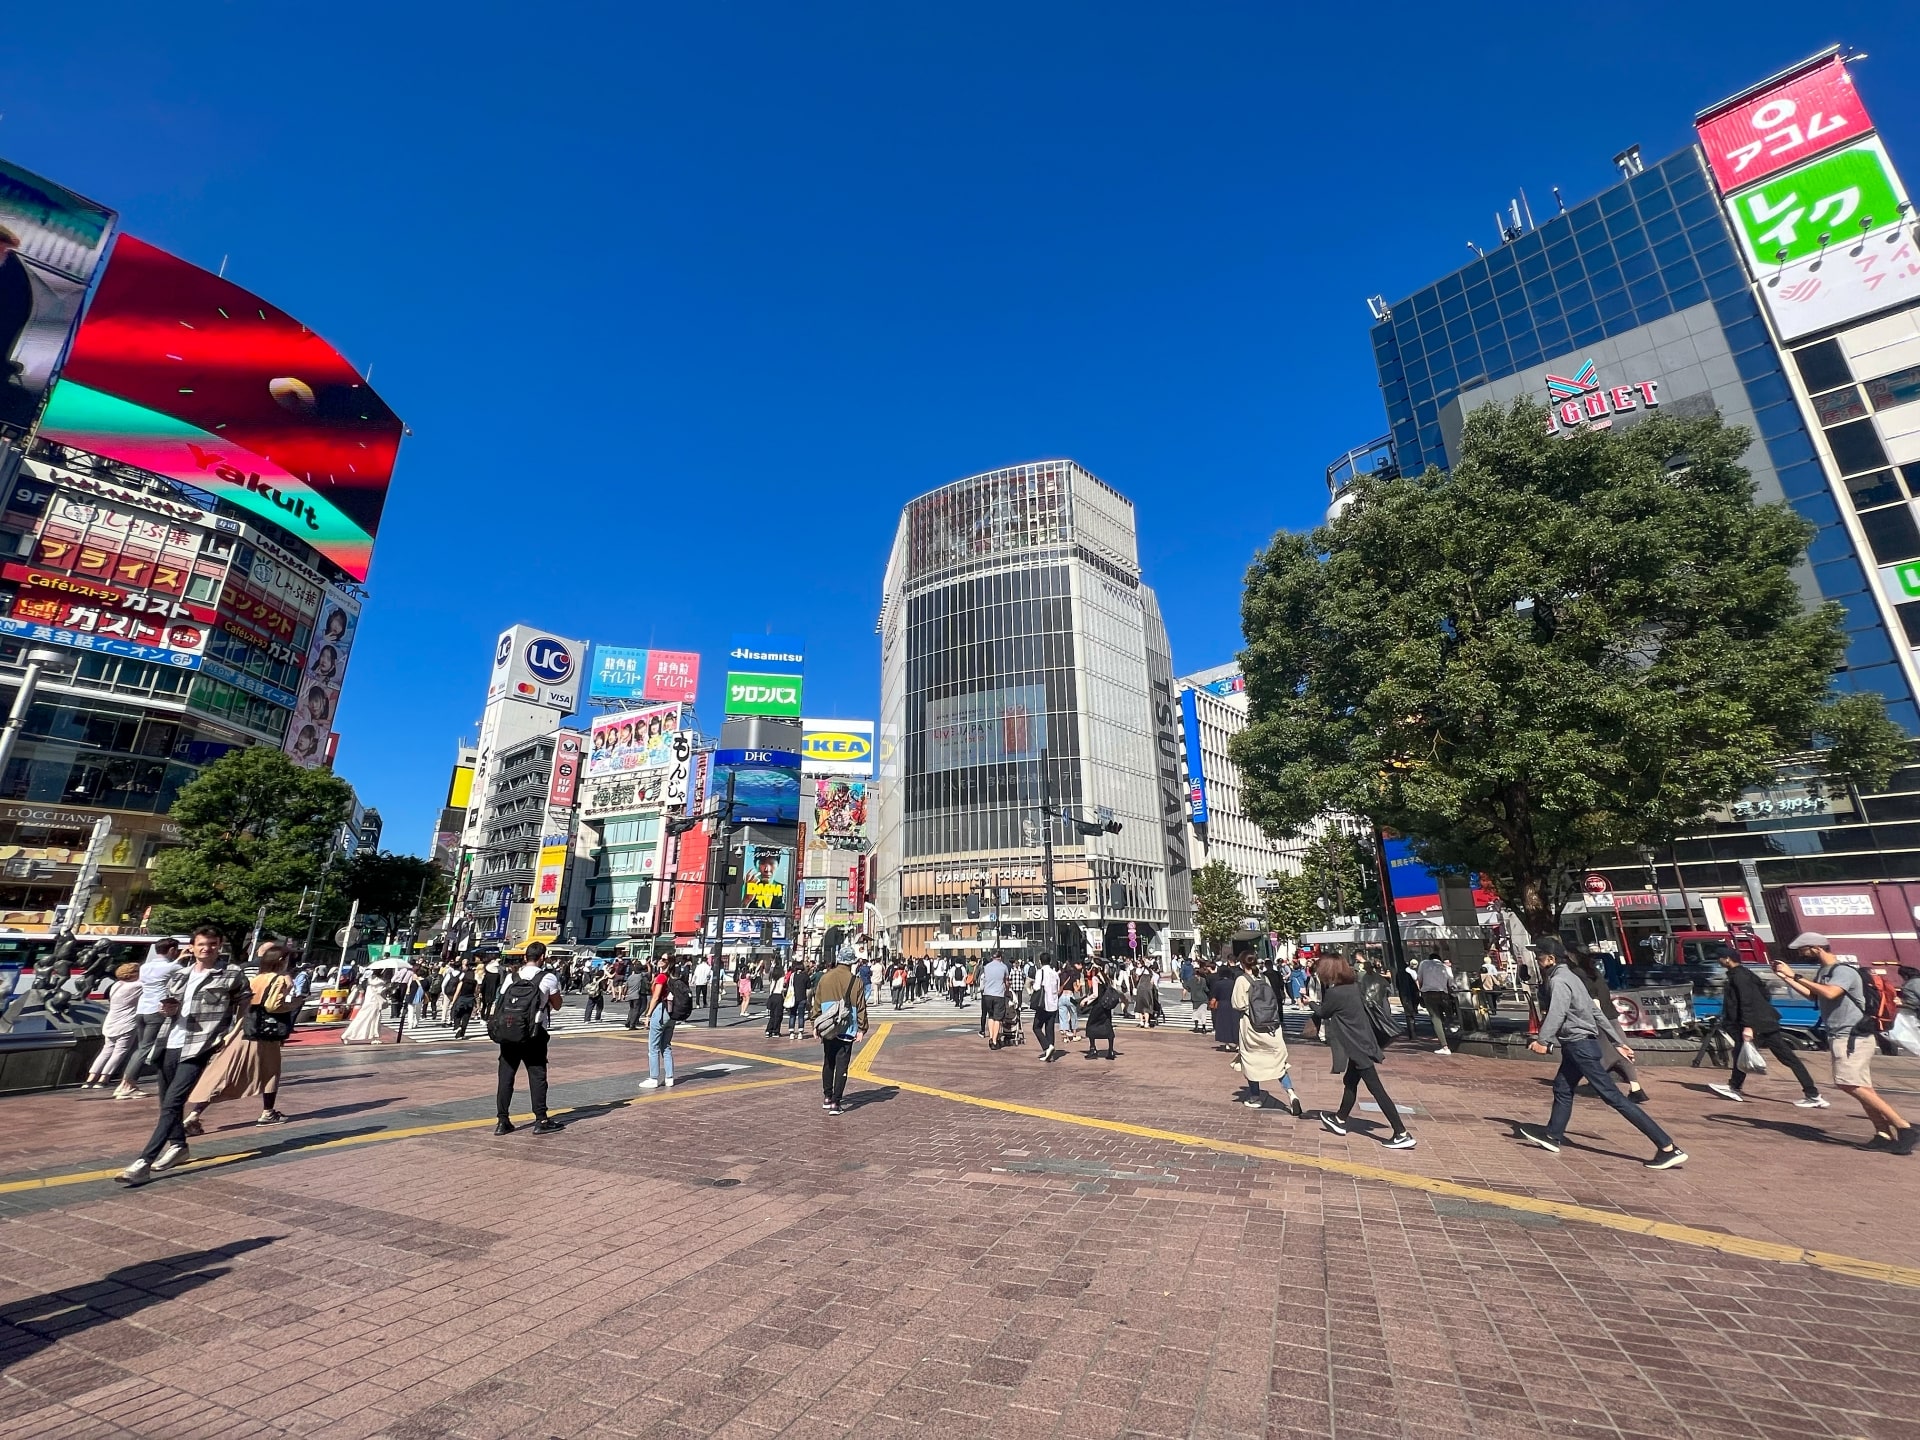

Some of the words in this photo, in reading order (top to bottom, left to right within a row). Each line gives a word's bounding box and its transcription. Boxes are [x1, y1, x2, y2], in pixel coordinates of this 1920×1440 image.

[1726, 111, 1848, 173] アコム
[1747, 186, 1861, 247] レイク
[16, 488, 48, 504] 9F
[186, 442, 320, 531] Yakult
[106, 509, 192, 546] しゃぶ葉
[41, 539, 182, 588] プライス
[27, 573, 120, 602] Caféレストラン
[122, 592, 191, 619] ガスト
[275, 570, 318, 607] しゃぶ葉
[220, 587, 293, 634] コンタクト
[63, 607, 155, 640] ガスト
[172, 632, 198, 644] ガスト
[173, 655, 192, 665] 6F
[267, 642, 300, 666] ガスト
[530, 644, 569, 673] UC
[730, 648, 803, 662] Hisamitsu
[550, 692, 570, 704] VISA
[731, 684, 797, 704] サロンパス
[744, 752, 772, 762] DHC
[802, 740, 866, 753] IKEA
[667, 731, 690, 802] もんじゃ
[1152, 677, 1187, 877] TSUTAYA
[1190, 776, 1203, 816] SEIBU
[6, 808, 99, 824] L'OCCITANE
[936, 871, 992, 884] STARBUCKS
[997, 869, 1037, 880] COFFEE
[747, 882, 783, 896] DMM
[756, 895, 774, 908] TV
[1023, 906, 1088, 920] TSUTAYA
